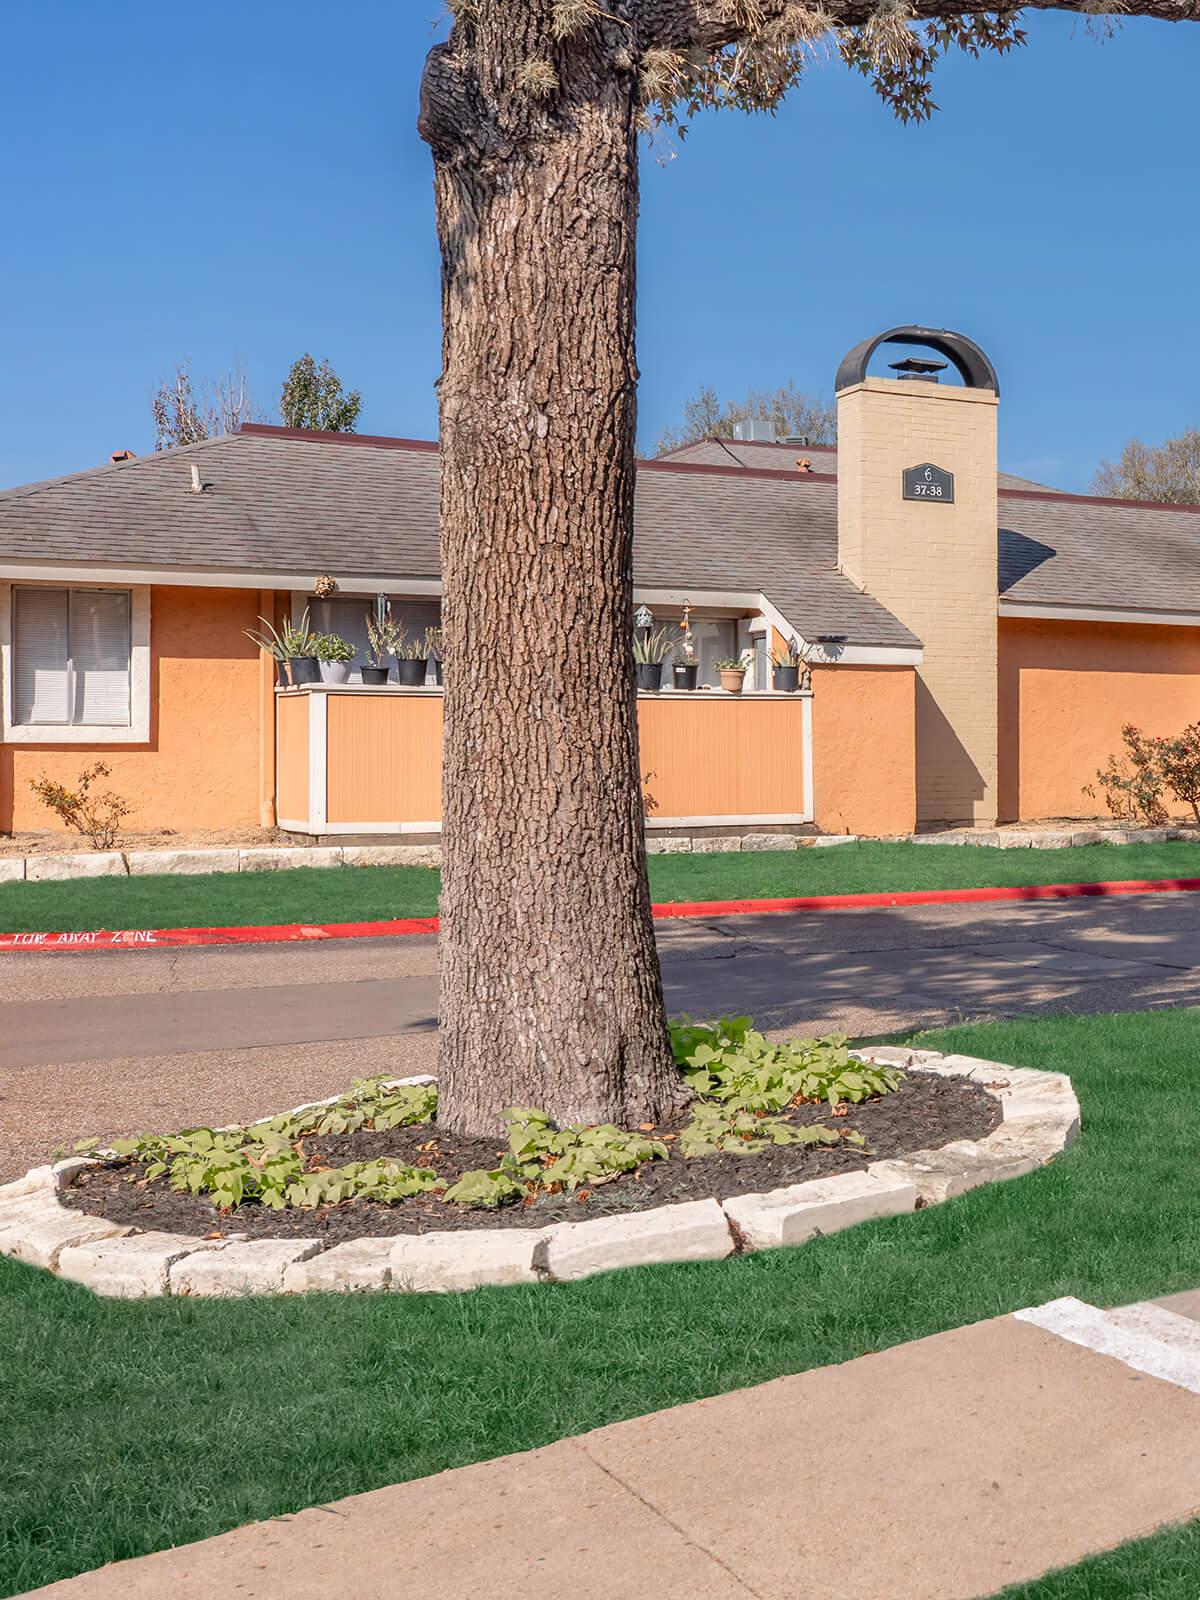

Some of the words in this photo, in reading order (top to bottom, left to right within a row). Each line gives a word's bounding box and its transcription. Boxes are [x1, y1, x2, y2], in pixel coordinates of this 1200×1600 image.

[925, 468, 932, 481] 6
[914, 485, 942, 496] 37-38
[111, 930, 159, 943] ZONE
